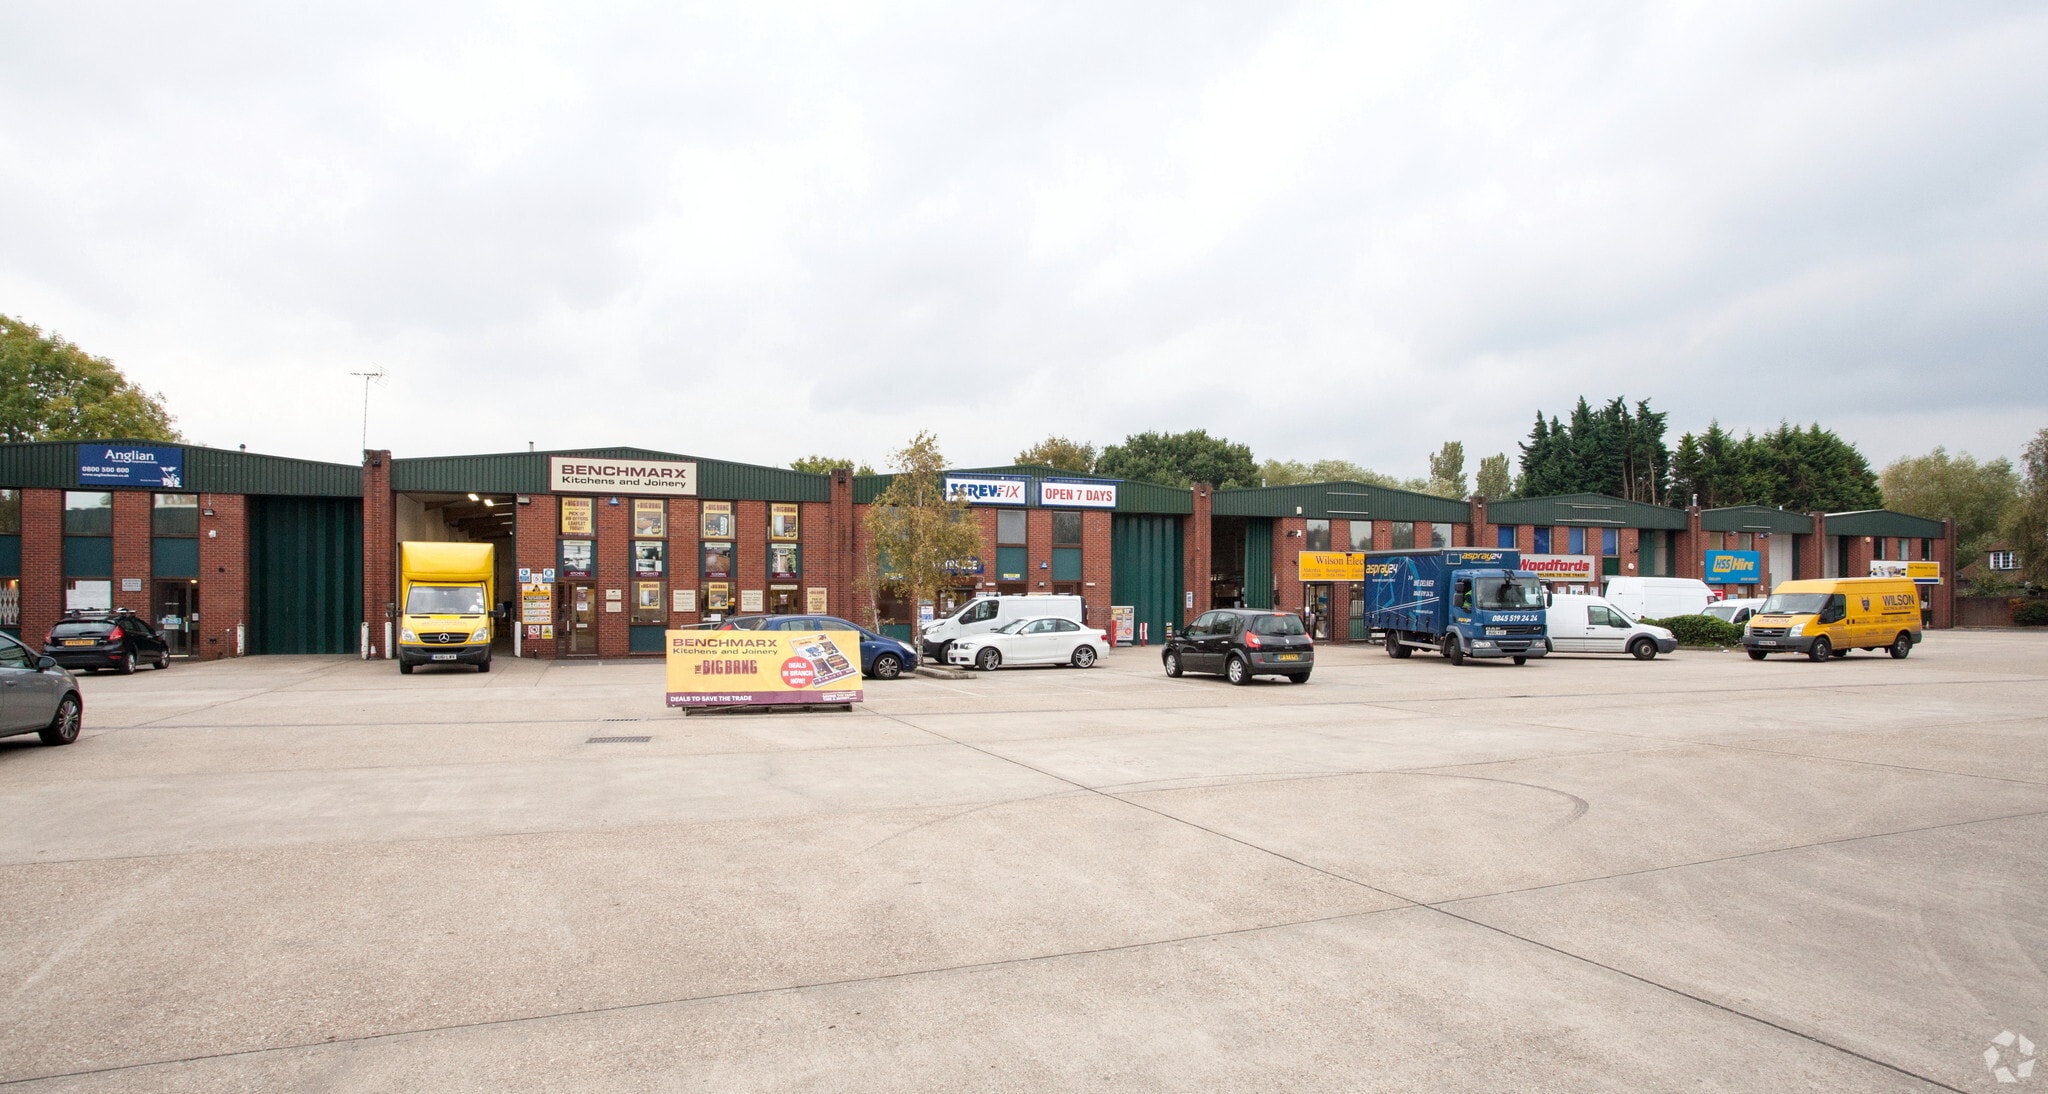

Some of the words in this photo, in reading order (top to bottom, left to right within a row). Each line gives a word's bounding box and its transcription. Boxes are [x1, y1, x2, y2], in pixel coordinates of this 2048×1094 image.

[104, 449, 154, 463] Anglian
[561, 464, 686, 478] BENCHMARX
[562, 476, 615, 485] Kitchens
[644, 479, 686, 488] Joinery
[950, 483, 1021, 499] SCREWFIX
[1045, 488, 1073, 500] OPEN
[1076, 489, 1083, 501] 7
[1086, 490, 1113, 502] DAYS
[1316, 555, 1344, 565] Wilson
[1462, 553, 1503, 561] aspray24
[1365, 563, 1399, 576] aspray24
[1520, 559, 1590, 571] Woodfords
[1715, 559, 1731, 569] HSS
[1732, 558, 1754, 570] Hire
[1882, 595, 1914, 605] WILSON
[673, 639, 777, 647] BENCHMARX
[703, 660, 723, 675] BIG
[725, 660, 758, 674] BANG
